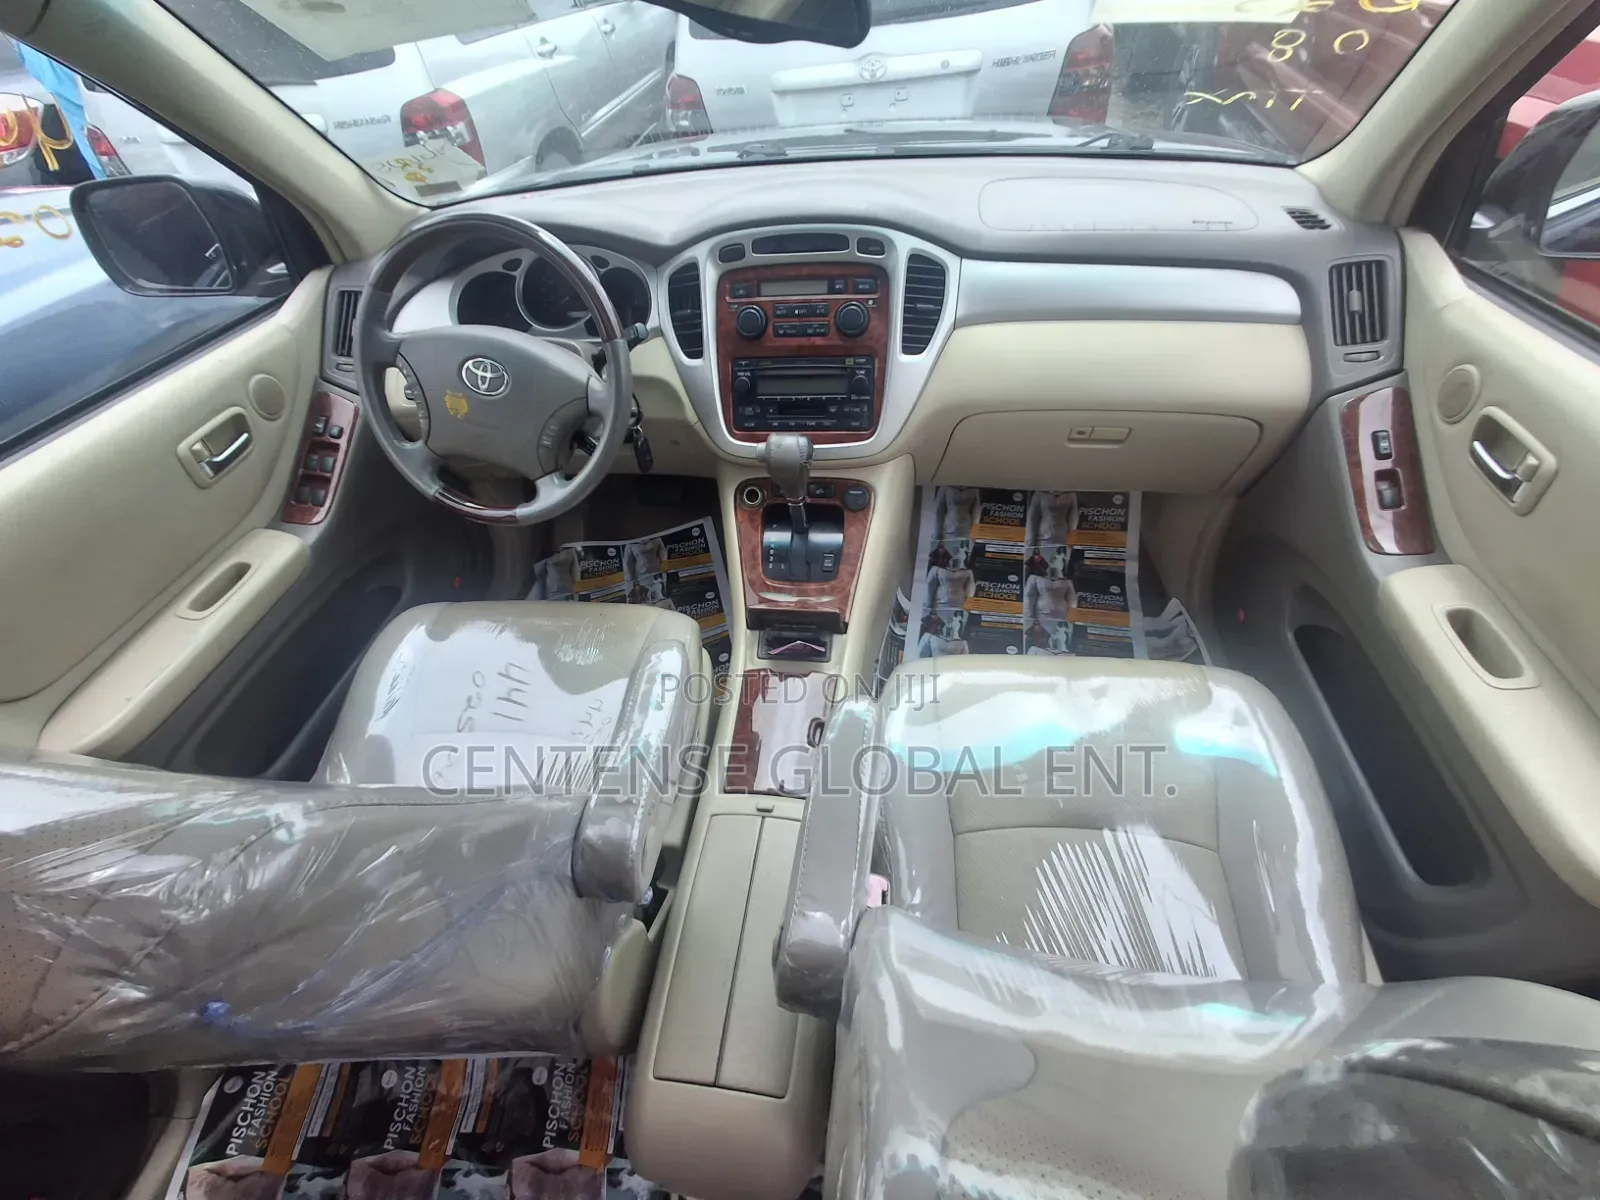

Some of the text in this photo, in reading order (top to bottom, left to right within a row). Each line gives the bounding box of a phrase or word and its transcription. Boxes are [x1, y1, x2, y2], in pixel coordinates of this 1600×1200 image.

[991, 48, 1057, 68] HIGHLANDER
[981, 503, 1025, 513] PISCHON
[1078, 507, 1126, 516] PISCHON
[989, 511, 1024, 519] FASHION
[667, 537, 705, 551] PISCHON
[675, 543, 706, 552] FASHION
[580, 557, 620, 568] PISCHON
[589, 563, 621, 573] FASHION
[975, 580, 1020, 590] PISCHON
[1076, 591, 1124, 602] PISCHON
[1087, 597, 1125, 606] FASHION
[677, 599, 719, 612] PISCHON
[687, 604, 720, 615] FASHION
[403, 1066, 427, 1131] FASHION
[559, 1062, 577, 1130] FASHION
[248, 1070, 278, 1137] FASHION
[383, 1066, 417, 1150] PISCHON
[542, 1063, 566, 1149] PISCHON
[225, 1071, 266, 1155] PISCHON
